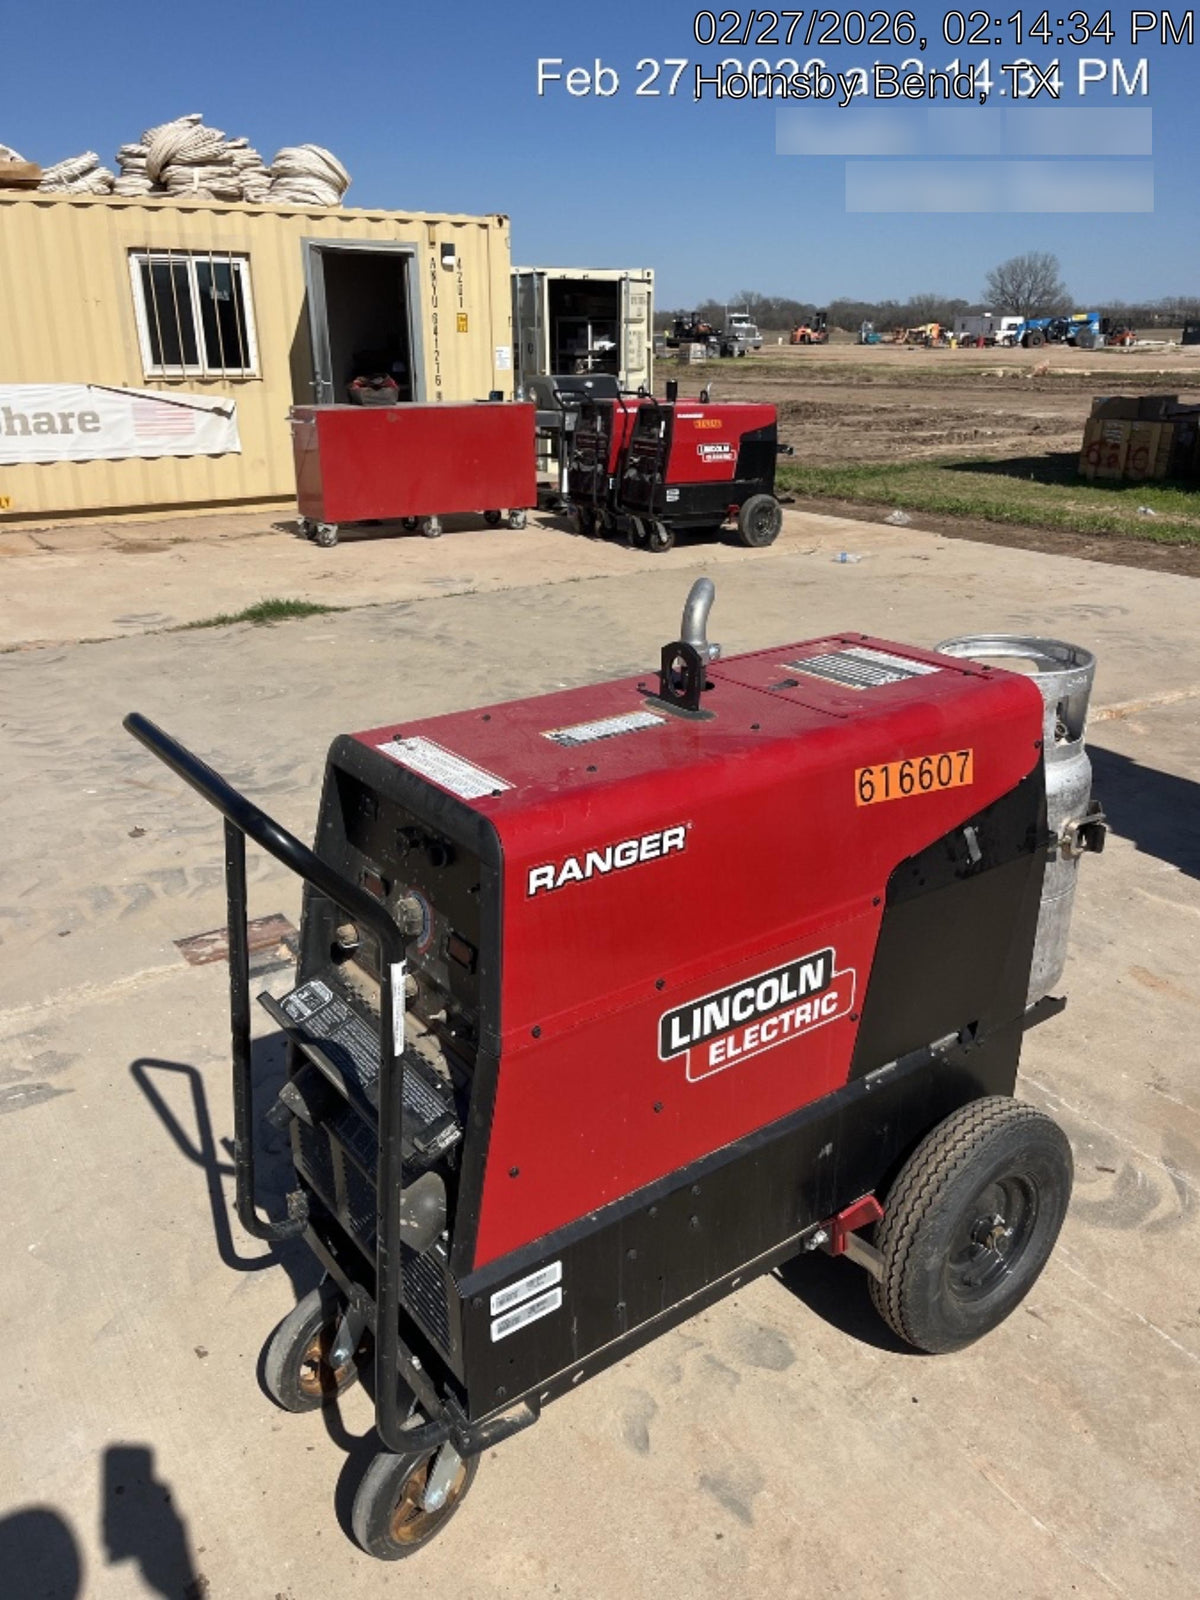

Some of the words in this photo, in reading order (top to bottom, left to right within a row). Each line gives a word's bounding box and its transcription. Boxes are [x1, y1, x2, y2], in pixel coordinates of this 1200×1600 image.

[0, 406, 101, 436] hare
[859, 751, 970, 802] 616607
[528, 826, 687, 896] RANGER
[671, 957, 825, 1050] LINCOLN
[708, 991, 839, 1067] ELECTRIC
